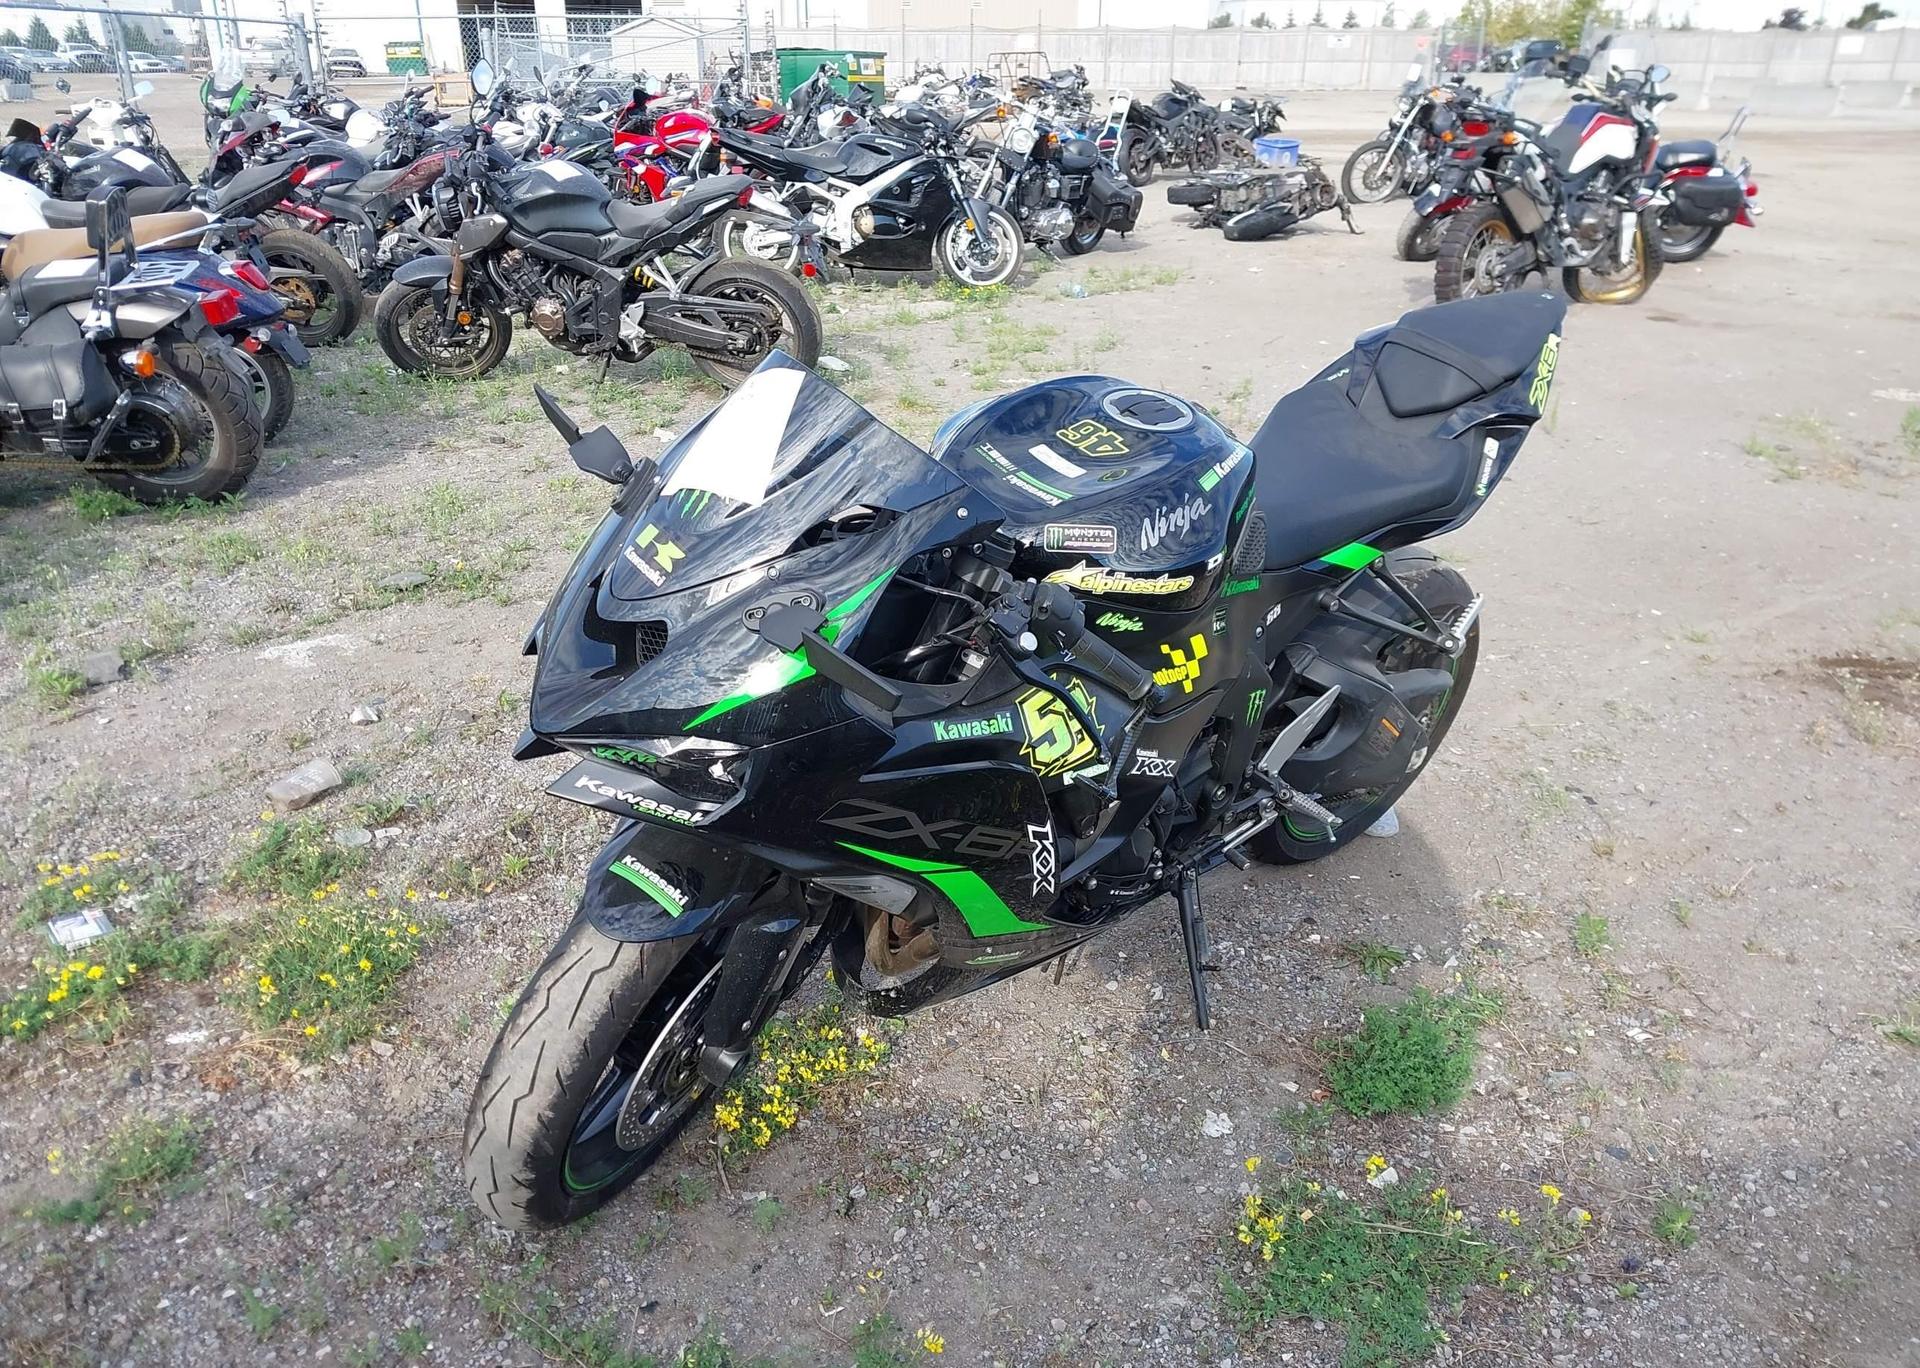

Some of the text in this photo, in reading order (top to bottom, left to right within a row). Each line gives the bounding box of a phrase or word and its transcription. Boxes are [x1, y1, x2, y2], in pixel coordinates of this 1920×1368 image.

[1056, 419, 1130, 456] 46
[1002, 475, 1063, 507] Kawasaki
[1140, 492, 1213, 551] Ninja
[1080, 572, 1193, 593] alpinestars
[1096, 612, 1144, 632] Ninja
[1152, 665, 1187, 686] otoGP
[933, 712, 1013, 742] Kawasaki
[1131, 757, 1177, 778] KX
[574, 774, 705, 823] Kawasak
[632, 804, 696, 827] TEAM RAC
[1027, 819, 1057, 899] KX
[621, 854, 689, 907] Kawasaki
